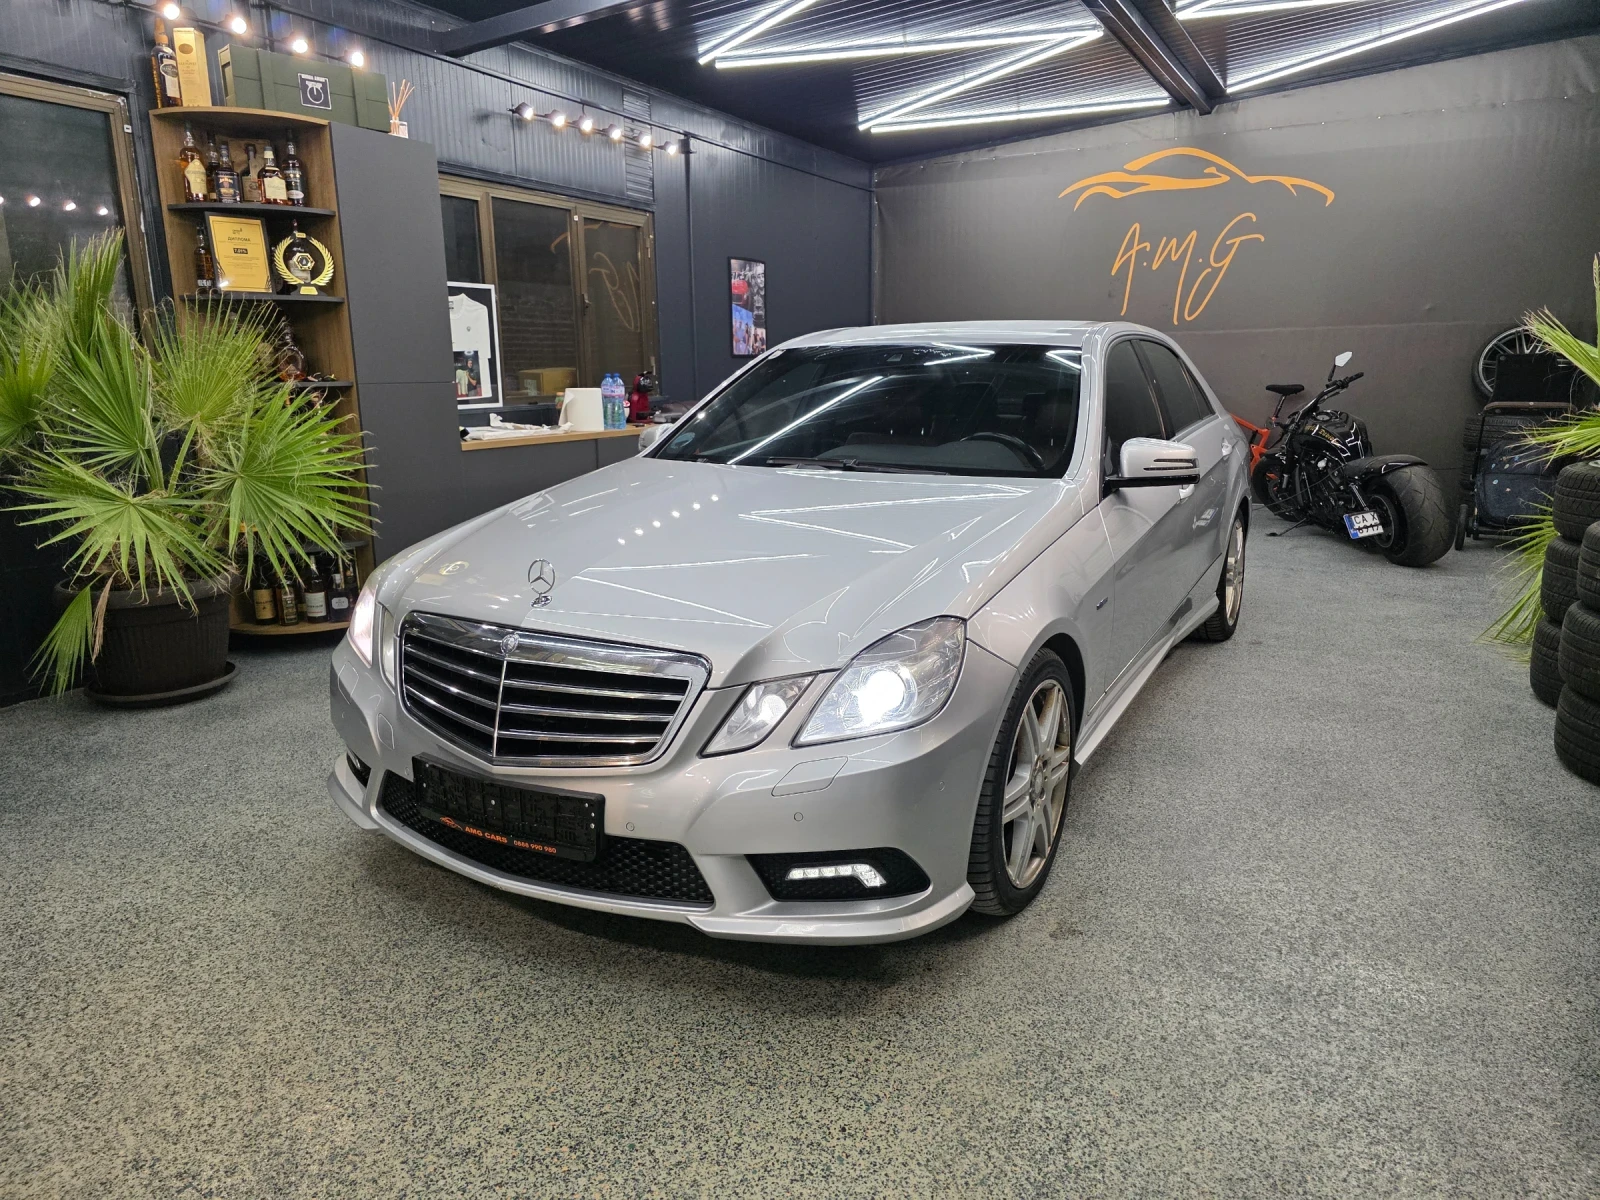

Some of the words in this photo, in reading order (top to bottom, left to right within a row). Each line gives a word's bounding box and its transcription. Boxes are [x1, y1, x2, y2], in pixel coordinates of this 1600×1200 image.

[465, 826, 483, 836] AMG
[484, 832, 508, 843] CARS
[530, 843, 543, 851] 990
